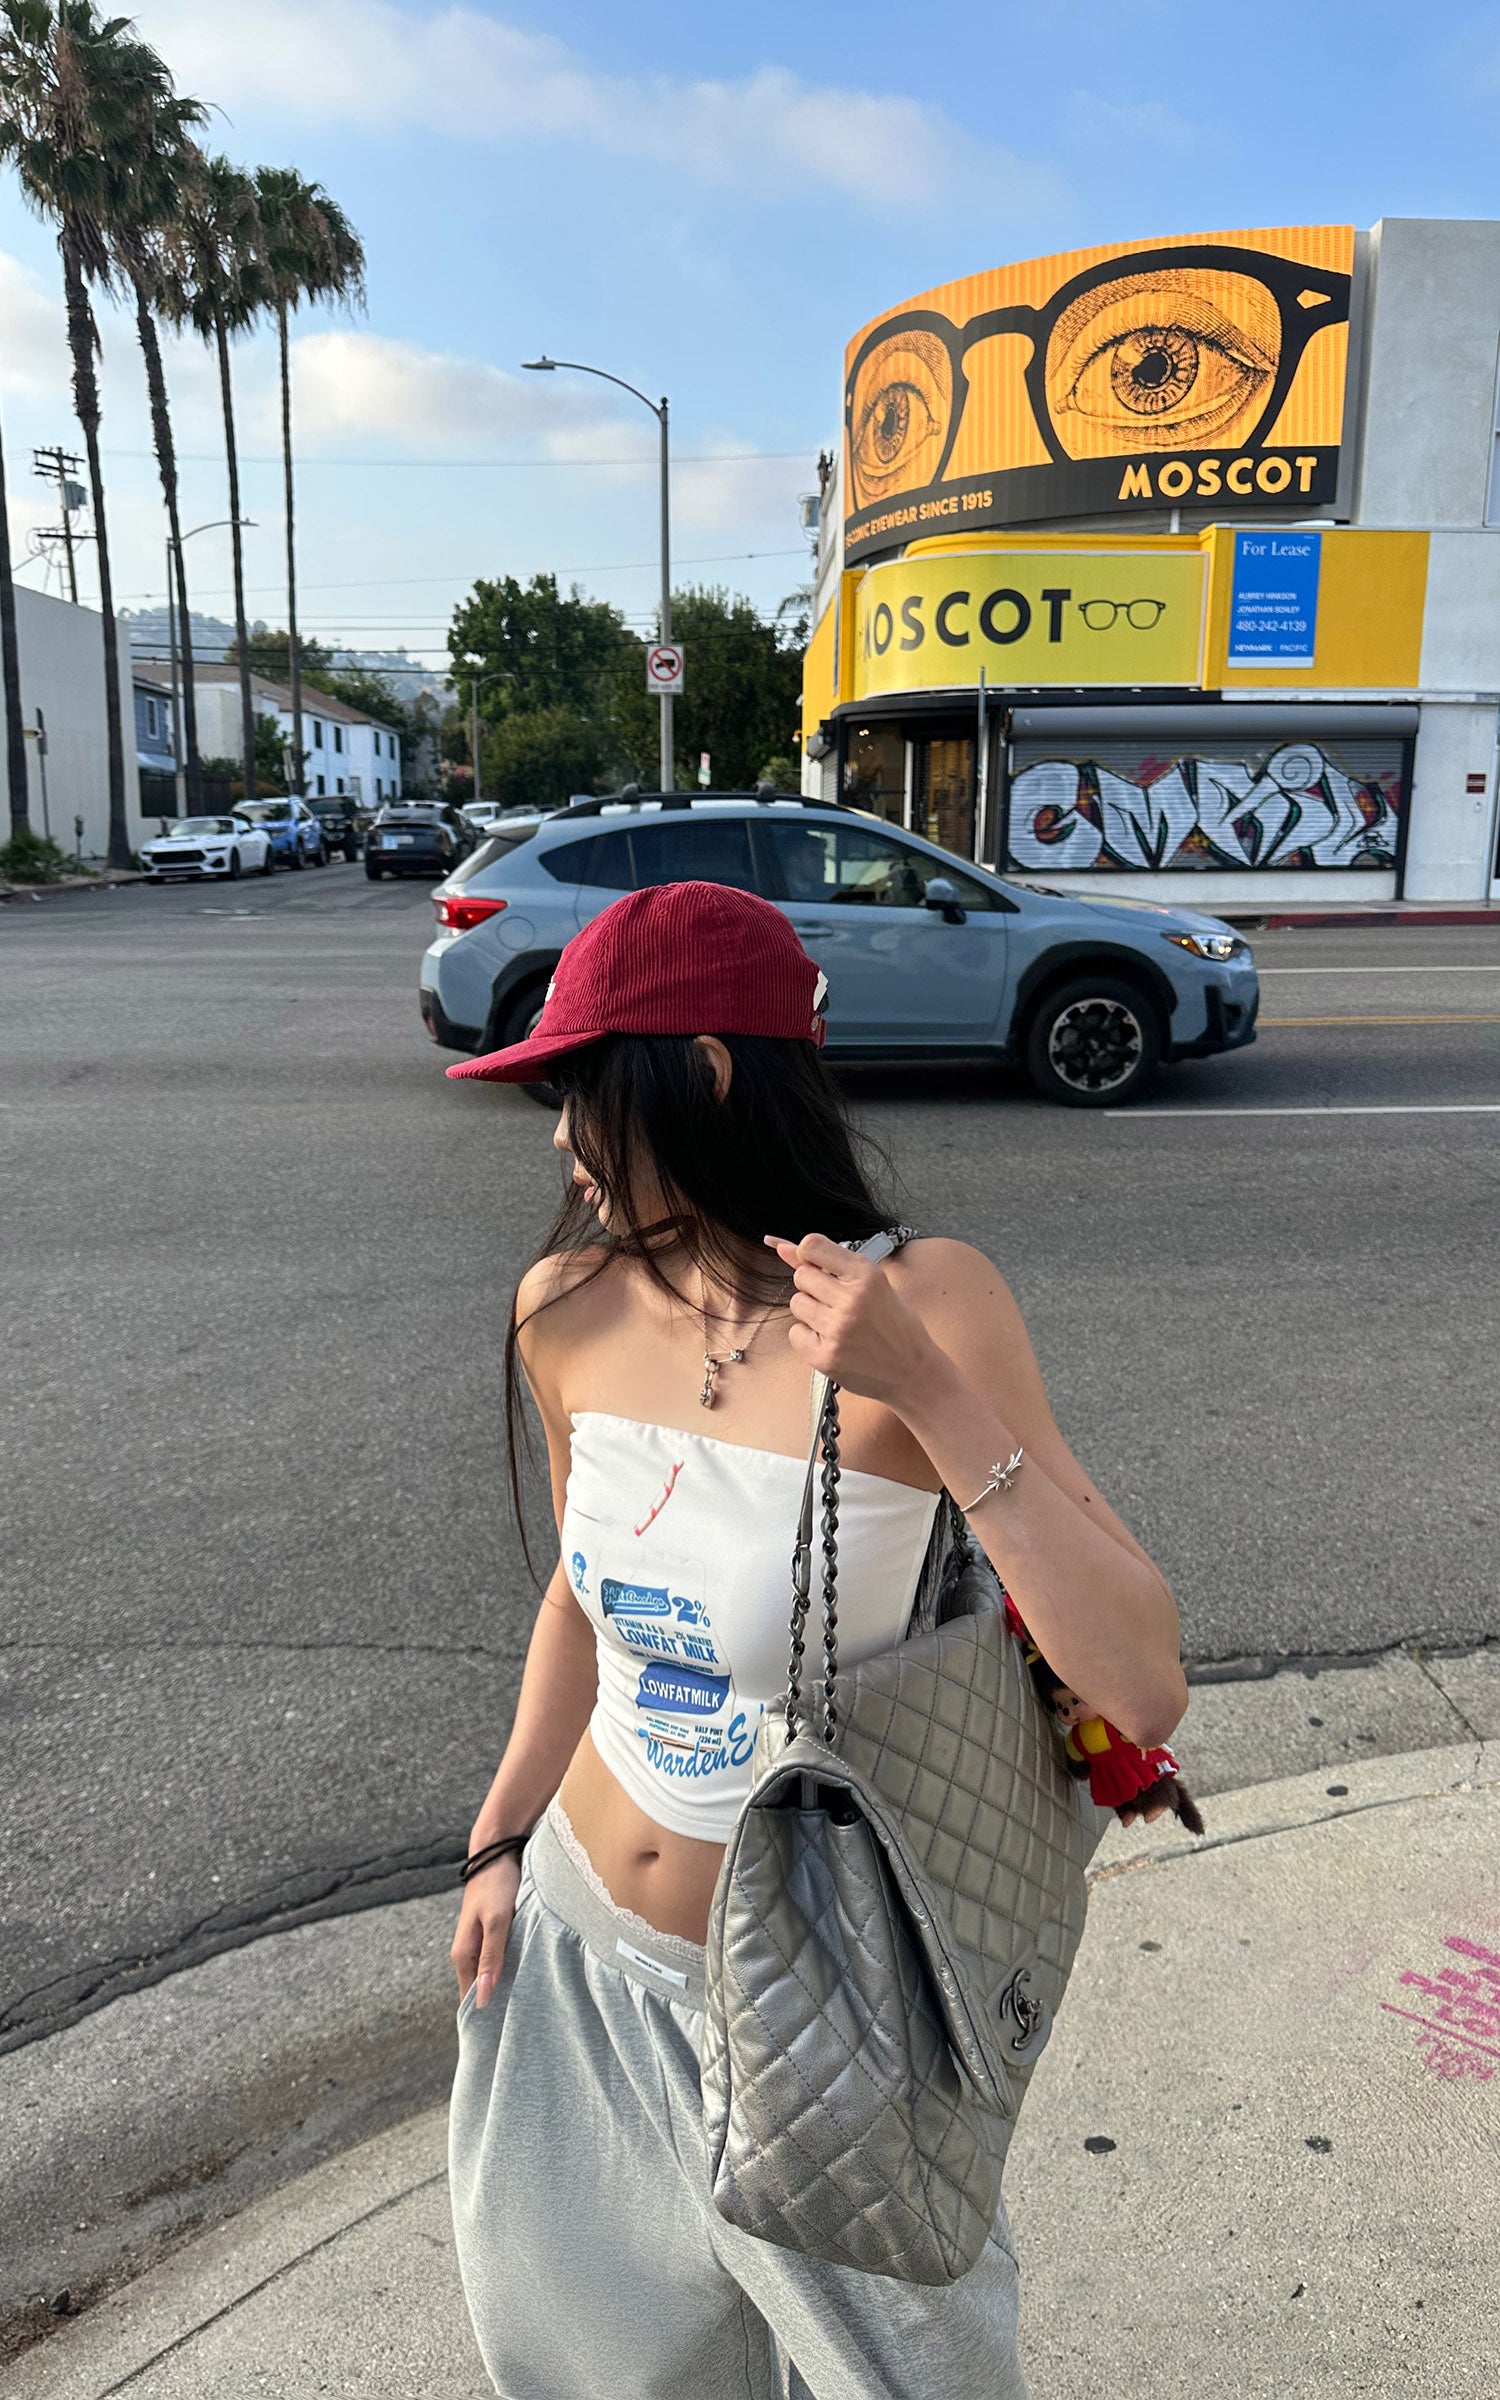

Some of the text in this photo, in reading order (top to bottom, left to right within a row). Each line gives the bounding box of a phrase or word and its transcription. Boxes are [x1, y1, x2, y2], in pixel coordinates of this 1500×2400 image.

[1118, 456, 1318, 500] MOSCOT
[871, 506, 918, 535] EYEWEAR
[919, 496, 959, 520] SINCE
[961, 490, 993, 511] 1915
[1242, 541, 1312, 557] For Lease
[672, 1596, 711, 1628] 2%
[616, 1626, 679, 1655] LOWFAT
[681, 1641, 720, 1664] MILK
[637, 1728, 730, 1778] Warden
